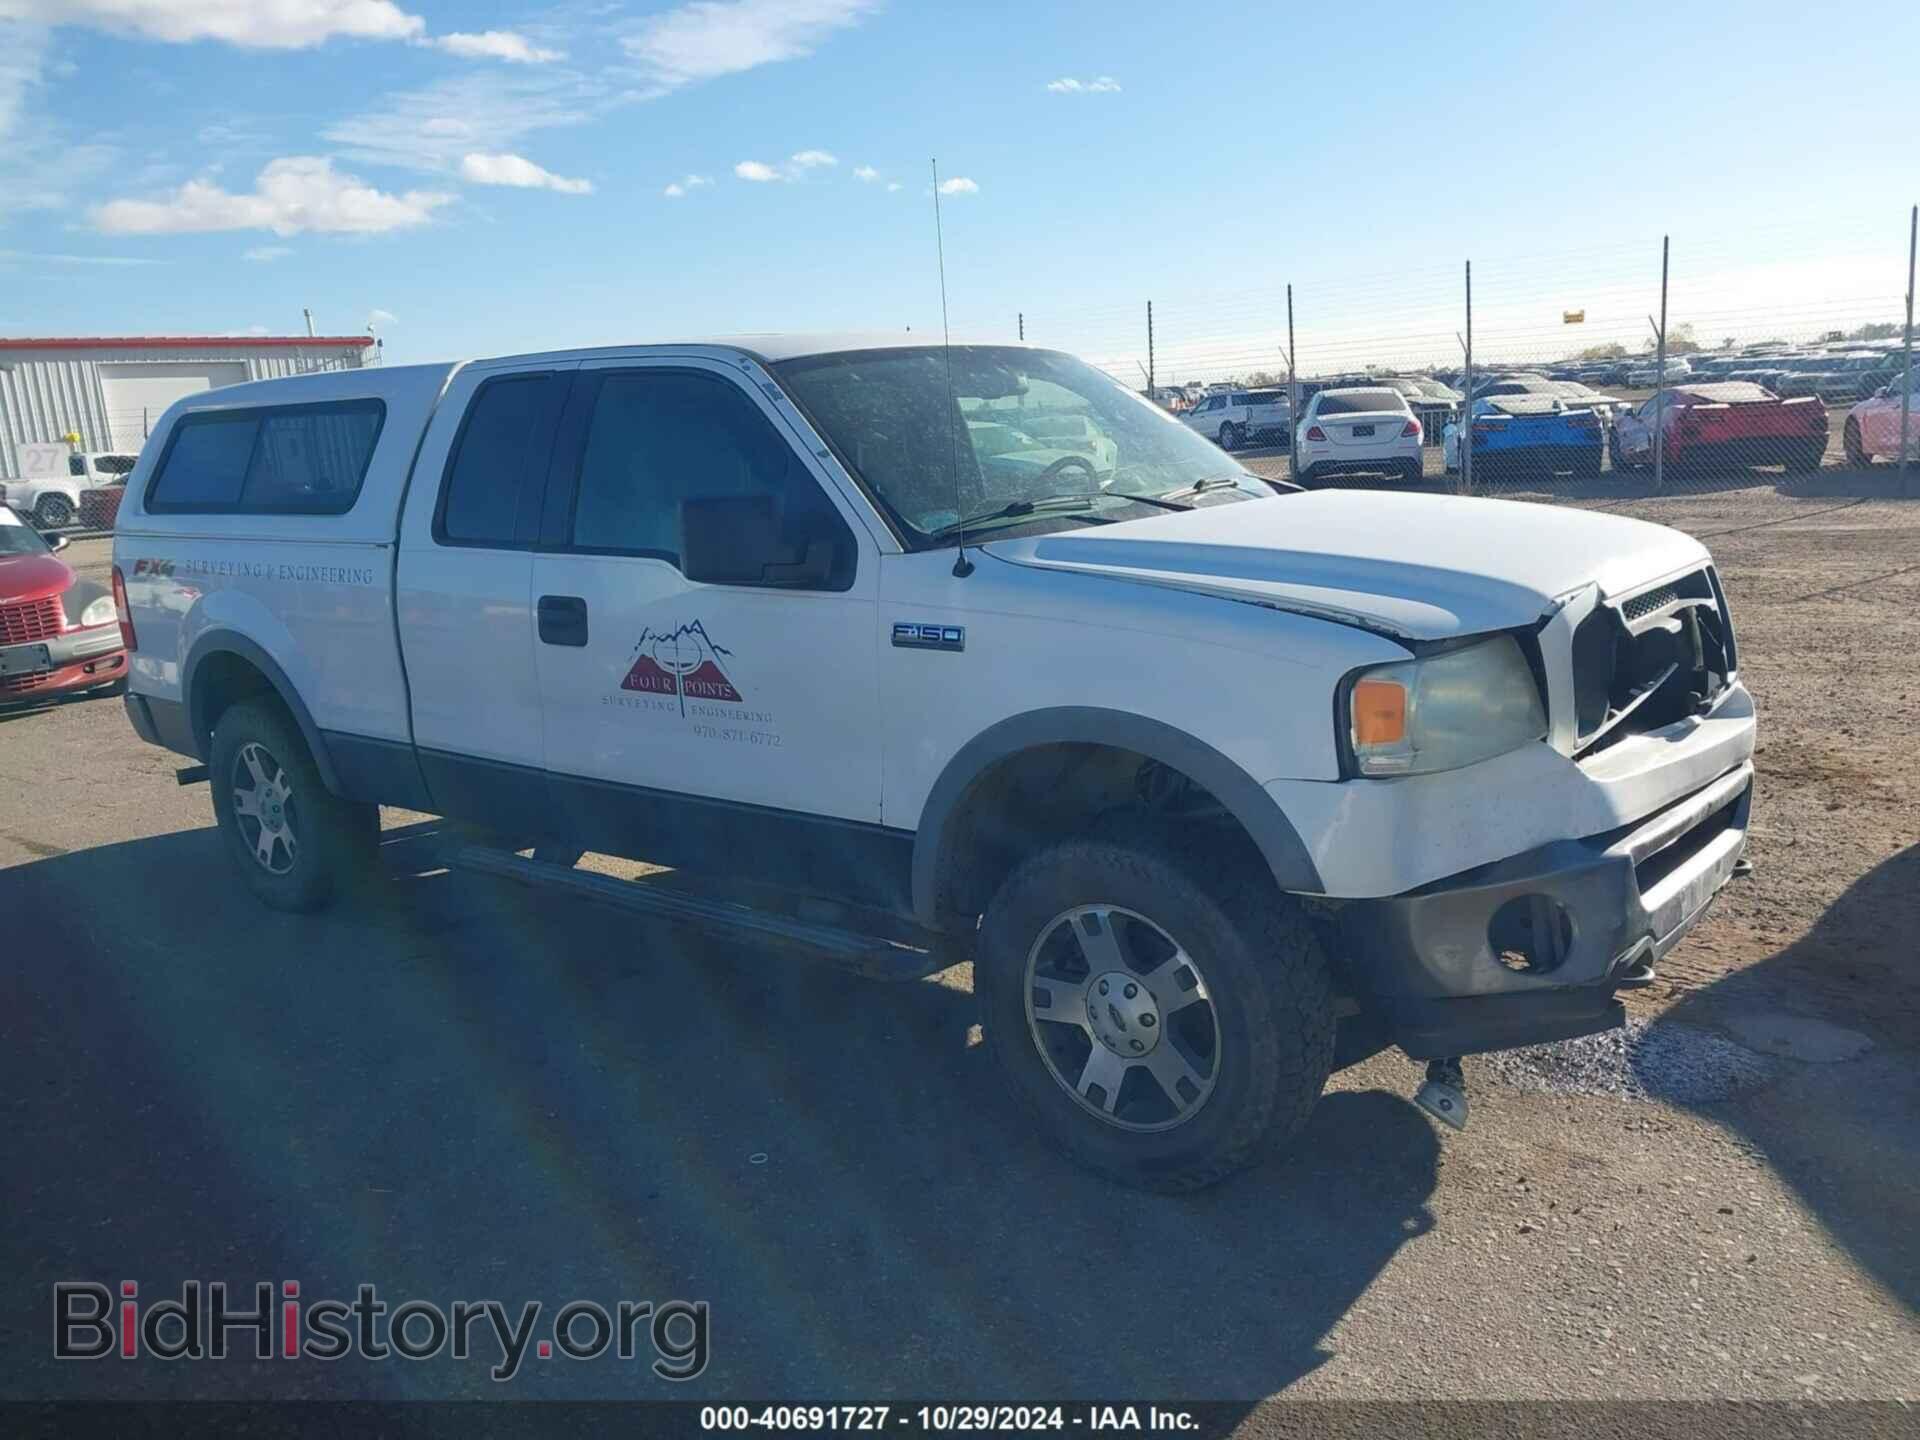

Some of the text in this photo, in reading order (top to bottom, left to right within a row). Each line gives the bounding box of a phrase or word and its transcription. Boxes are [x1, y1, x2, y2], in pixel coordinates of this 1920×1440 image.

[25, 448, 59, 472] 27
[133, 559, 176, 577] FX4
[185, 559, 262, 577] SURVEYING
[279, 564, 373, 584] ENGINEERING
[629, 673, 732, 698] FOUR POINTS
[601, 696, 774, 724] SURVEYING ENGINEERING
